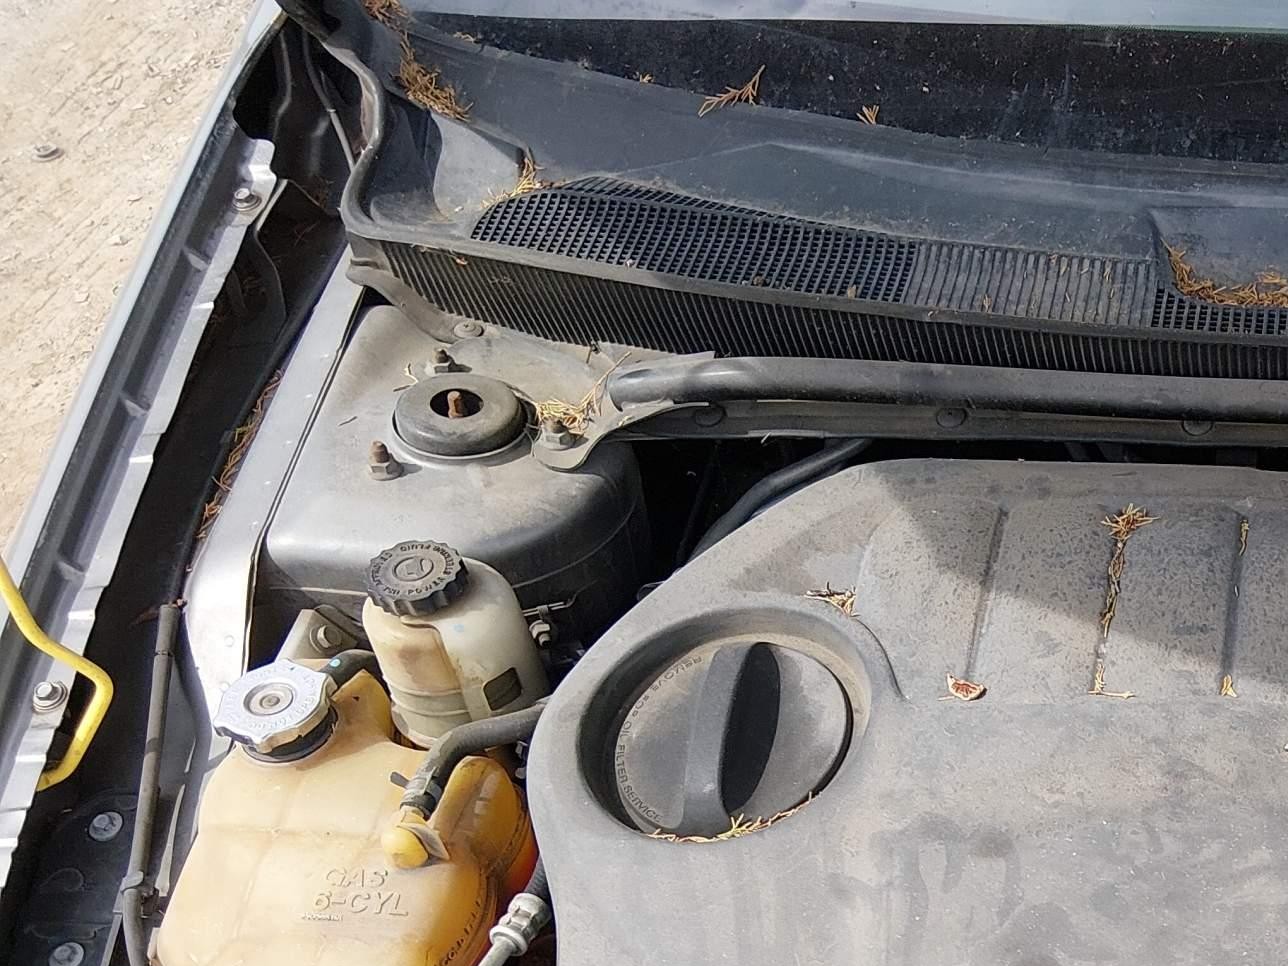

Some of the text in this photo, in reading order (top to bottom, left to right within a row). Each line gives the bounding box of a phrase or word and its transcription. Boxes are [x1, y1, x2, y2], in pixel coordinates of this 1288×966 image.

[615, 655, 703, 823] REMOVE FOR OIL FILTER SERVICE
[326, 868, 388, 888] GAS
[313, 890, 409, 917] 6-CYL
